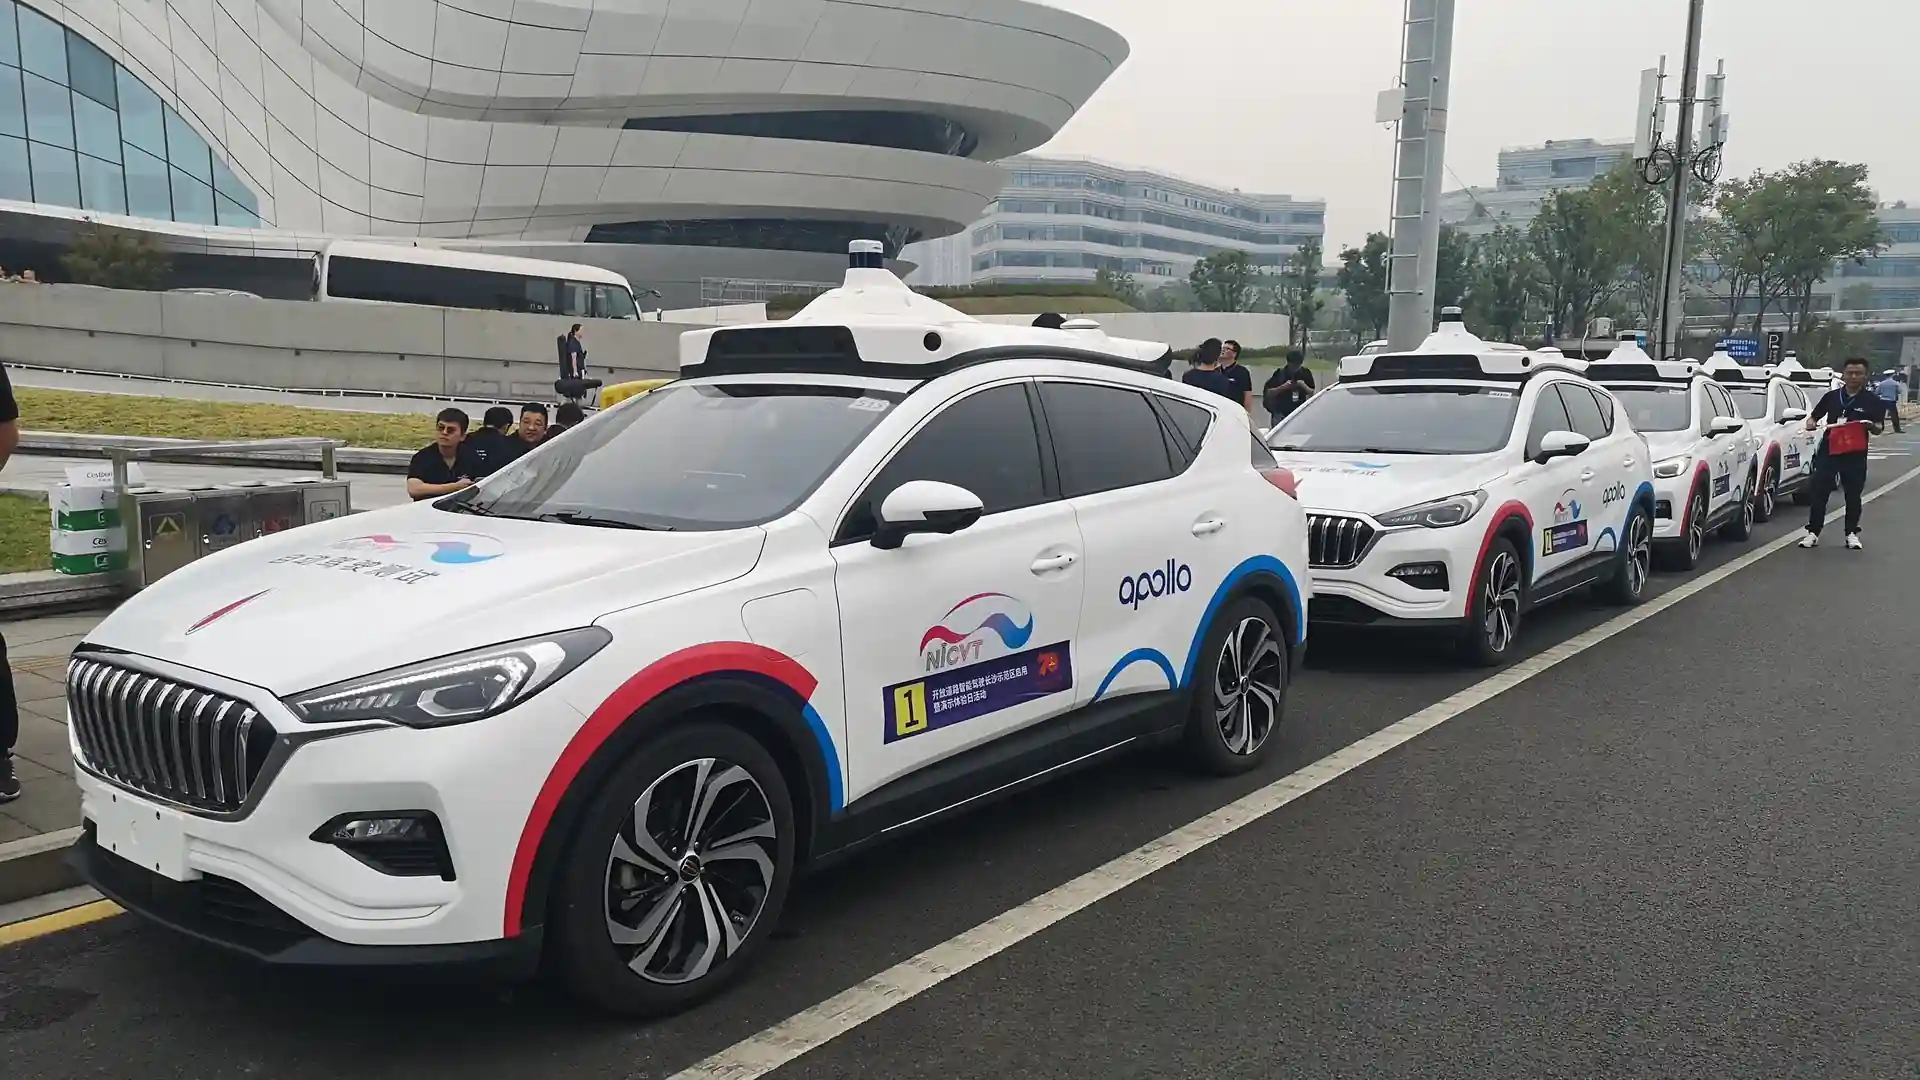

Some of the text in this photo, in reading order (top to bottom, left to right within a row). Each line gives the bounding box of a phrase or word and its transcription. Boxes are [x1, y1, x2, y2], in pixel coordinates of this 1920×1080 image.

[1118, 558, 1192, 611] apollo
[925, 639, 984, 672] NICVT
[903, 689, 919, 728] 1
